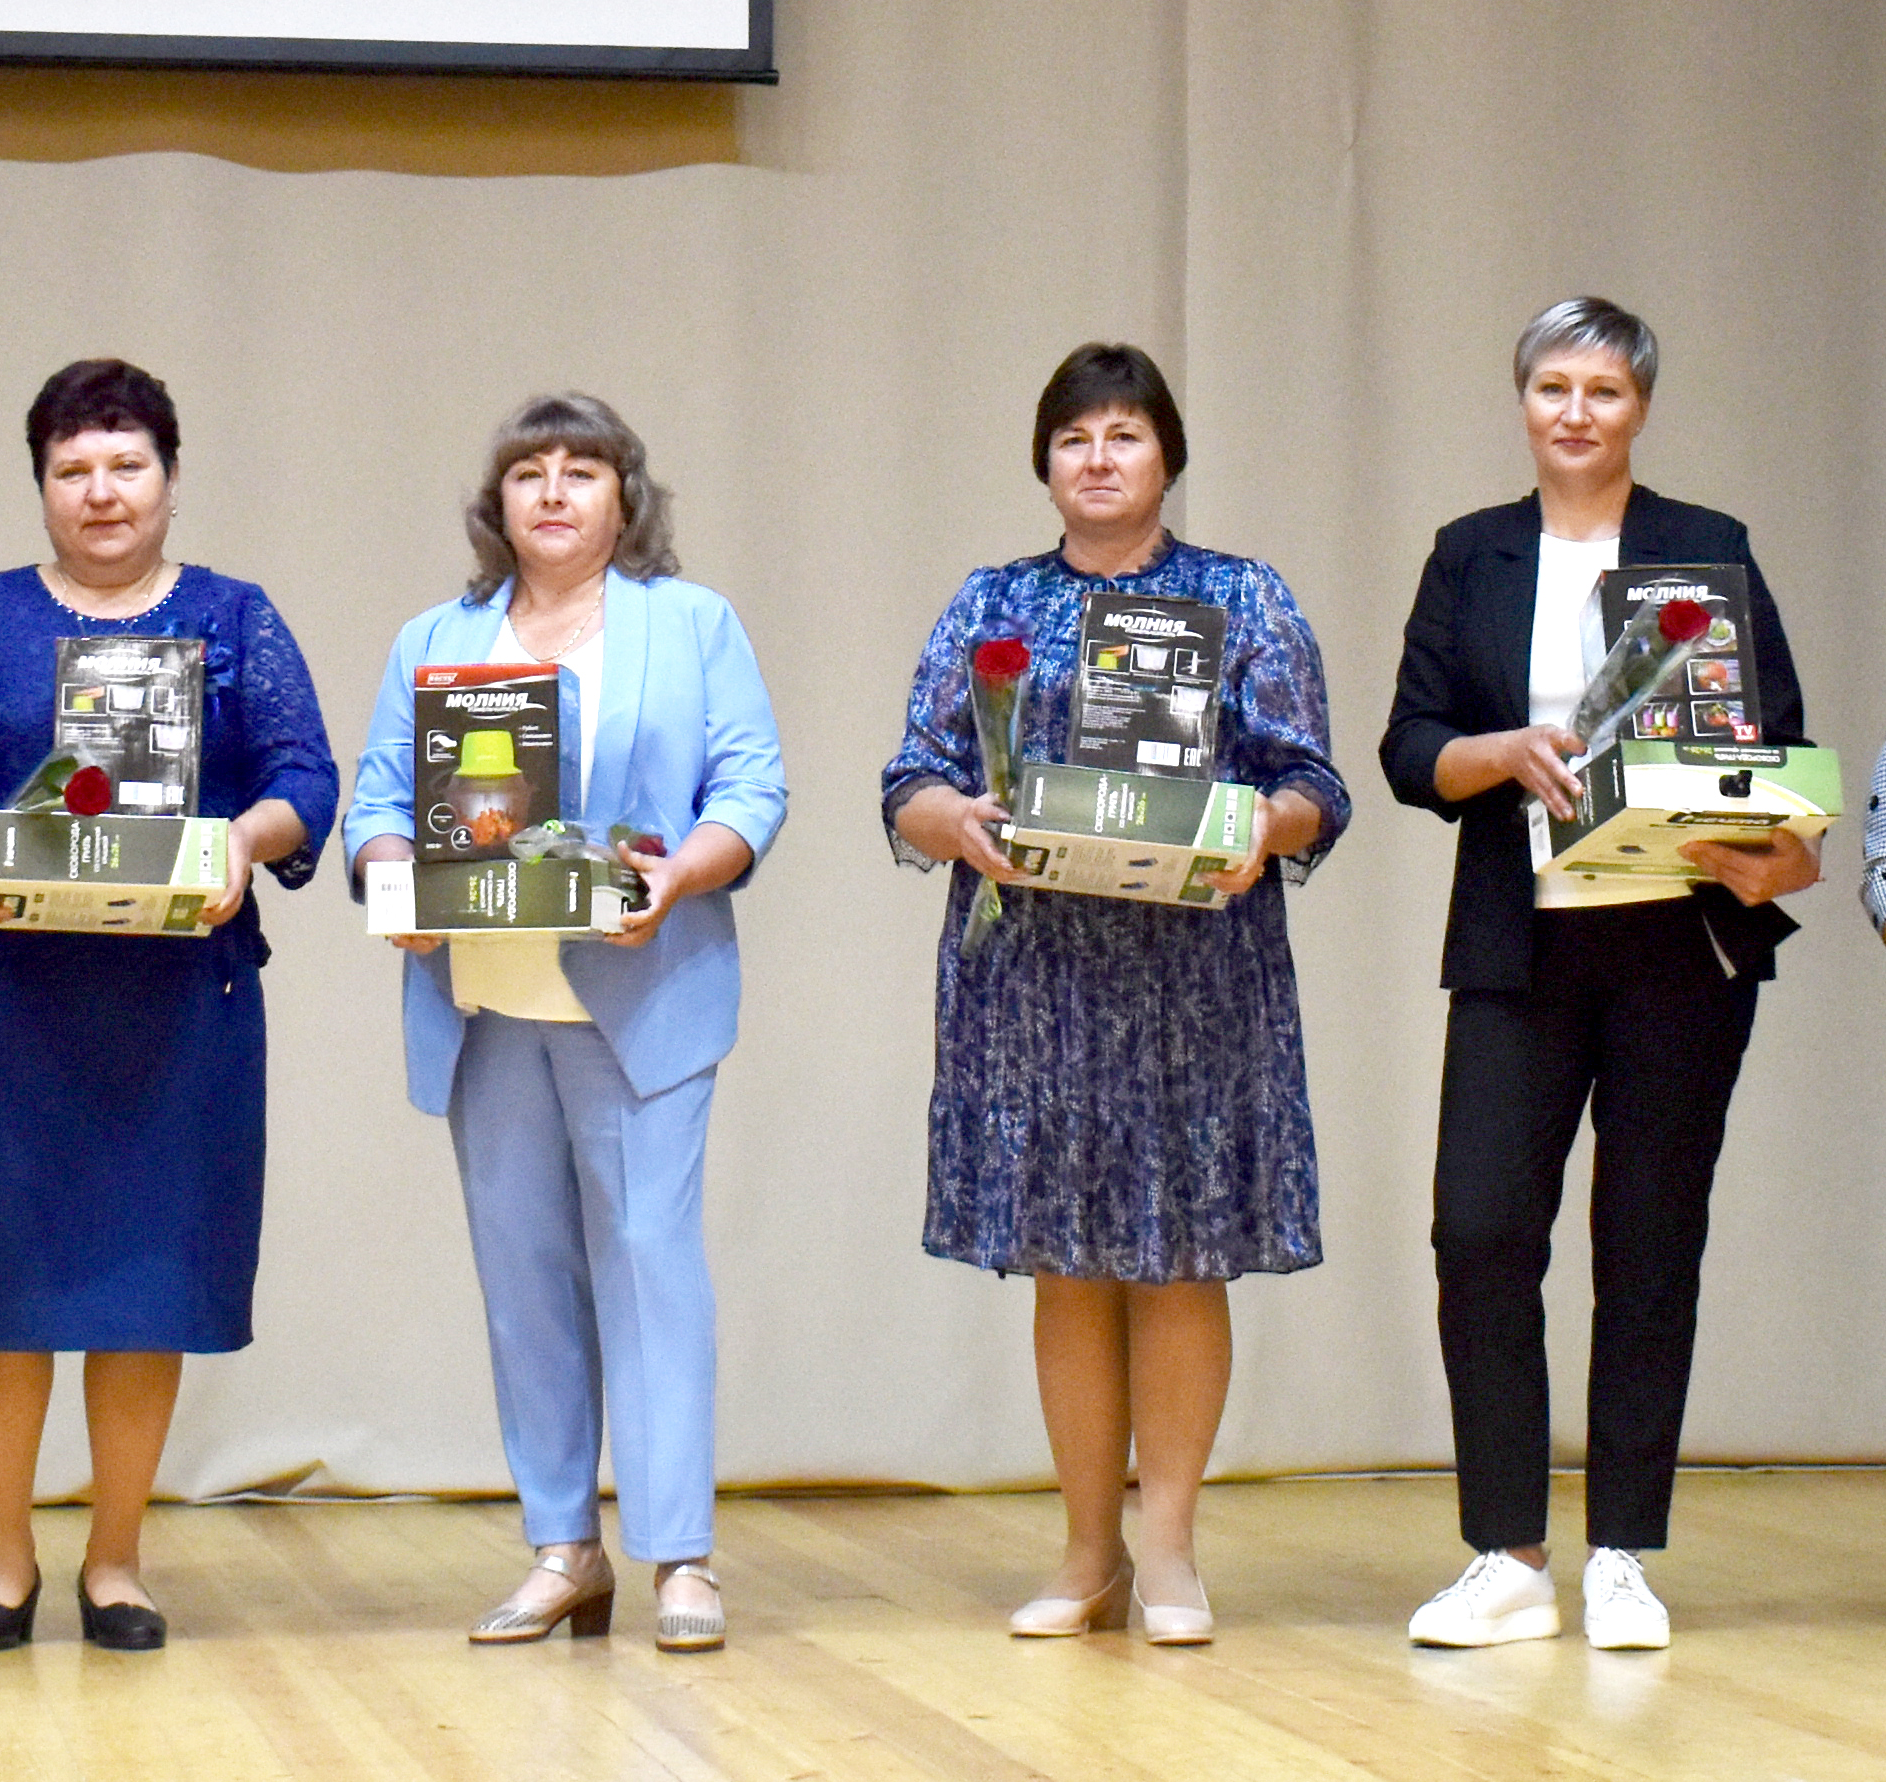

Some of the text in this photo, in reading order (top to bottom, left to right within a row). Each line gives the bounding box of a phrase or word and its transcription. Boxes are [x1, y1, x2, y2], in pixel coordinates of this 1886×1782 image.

[1627, 585, 1709, 602] МОЛНИЯ
[1103, 613, 1188, 633] МОЛНИЯ
[77, 655, 162, 671] МОЛНИЯ
[445, 692, 530, 709] МОЛНИЯ
[1733, 725, 1754, 736] TV
[458, 830, 468, 841] 2
